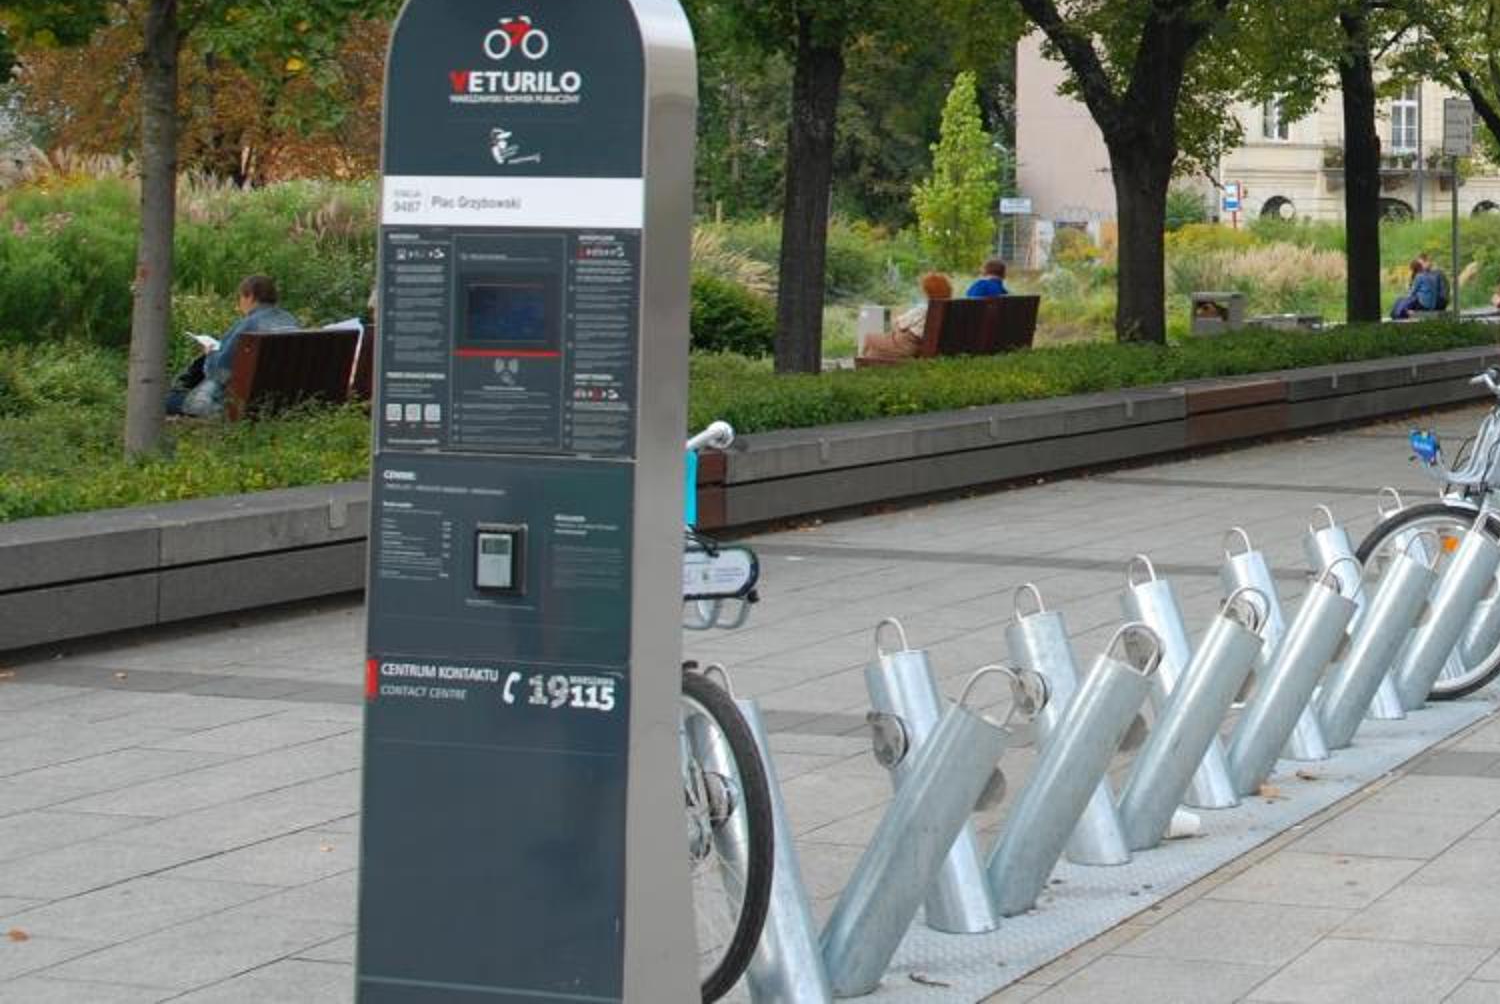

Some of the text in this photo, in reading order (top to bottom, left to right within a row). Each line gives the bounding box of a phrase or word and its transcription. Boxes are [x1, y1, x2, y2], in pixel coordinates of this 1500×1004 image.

[449, 69, 582, 94] VETURILO
[431, 195, 522, 210] Plac Grzybowski
[380, 662, 499, 682] CENTRUM KONTAKTU
[380, 685, 467, 700] CONTACT CENTRE
